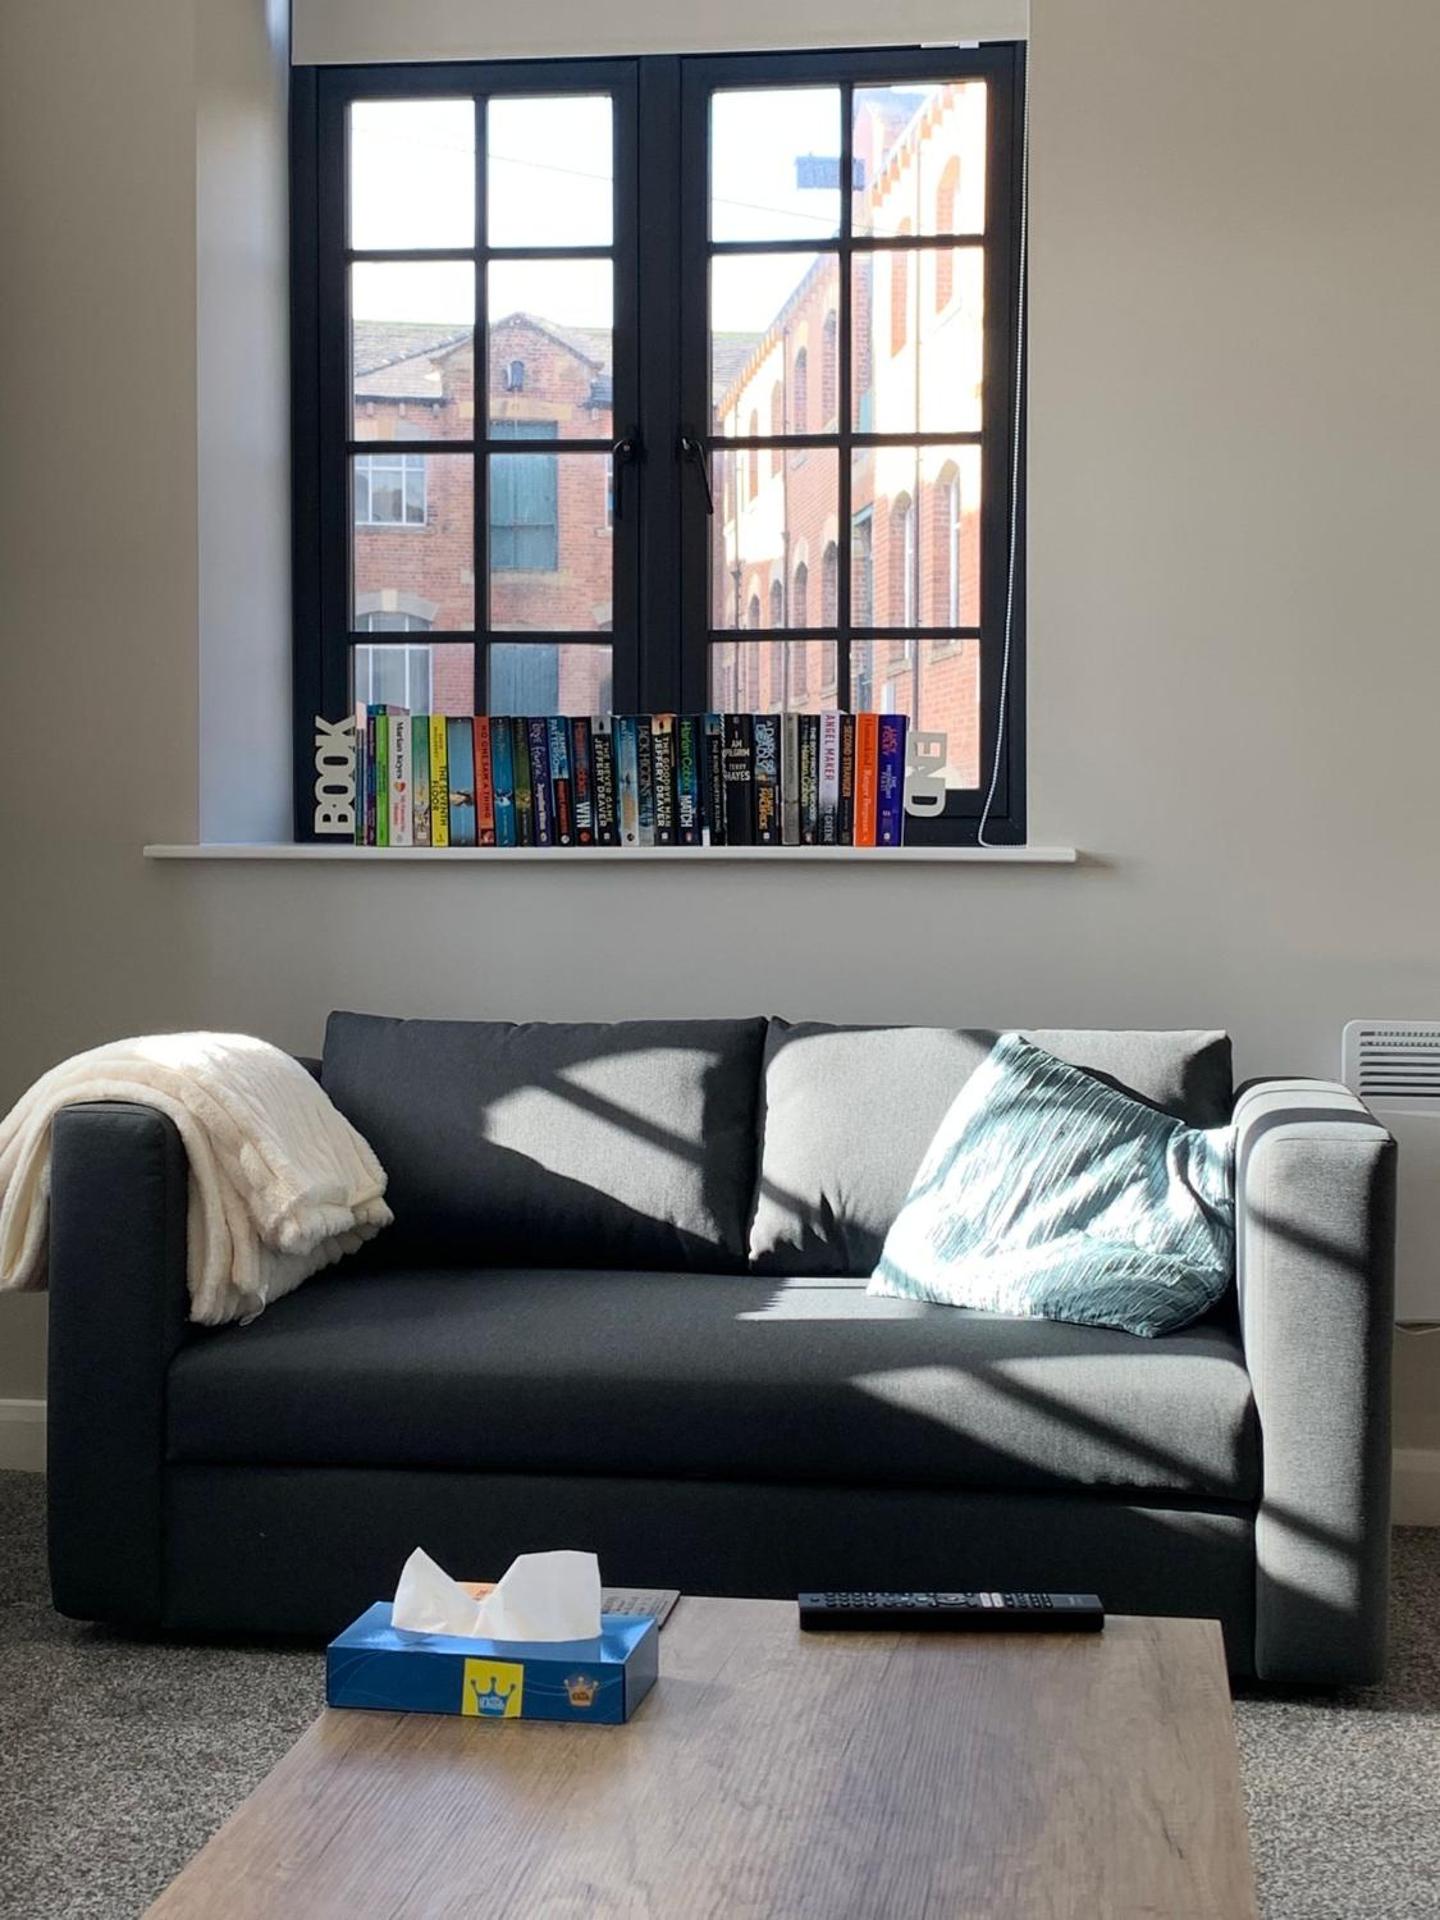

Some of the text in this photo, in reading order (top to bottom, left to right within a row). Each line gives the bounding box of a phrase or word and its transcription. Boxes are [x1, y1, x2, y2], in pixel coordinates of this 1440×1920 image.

[395, 722, 404, 779] Marian Keyes
[481, 740, 489, 758] ONE
[550, 719, 560, 778] PATTERSON
[558, 731, 567, 760] JAMES
[638, 724, 651, 749] JACK
[680, 721, 692, 756] Harlan
[755, 724, 767, 769] DEADLY
[766, 728, 775, 758] DARK
[824, 715, 836, 781] ANGEL MAKER
[843, 725, 852, 756] SECOND
[314, 715, 356, 834] BOOK
[594, 738, 607, 827] JEFFERY DEAVER
[603, 762, 611, 793] NEVER
[639, 751, 652, 795] HIGGINS
[654, 737, 665, 827] JEFFERY DEAVER
[662, 758, 671, 802] GOODBYE
[723, 770, 751, 781] HAYES
[842, 757, 852, 797] STRANGER
[904, 732, 948, 817] END
[432, 780, 440, 811] FLOOR
[439, 766, 448, 827] THE SEVENTH
[605, 796, 613, 823] GAME
[680, 795, 693, 828] MATCH
[576, 801, 591, 828] WIN
